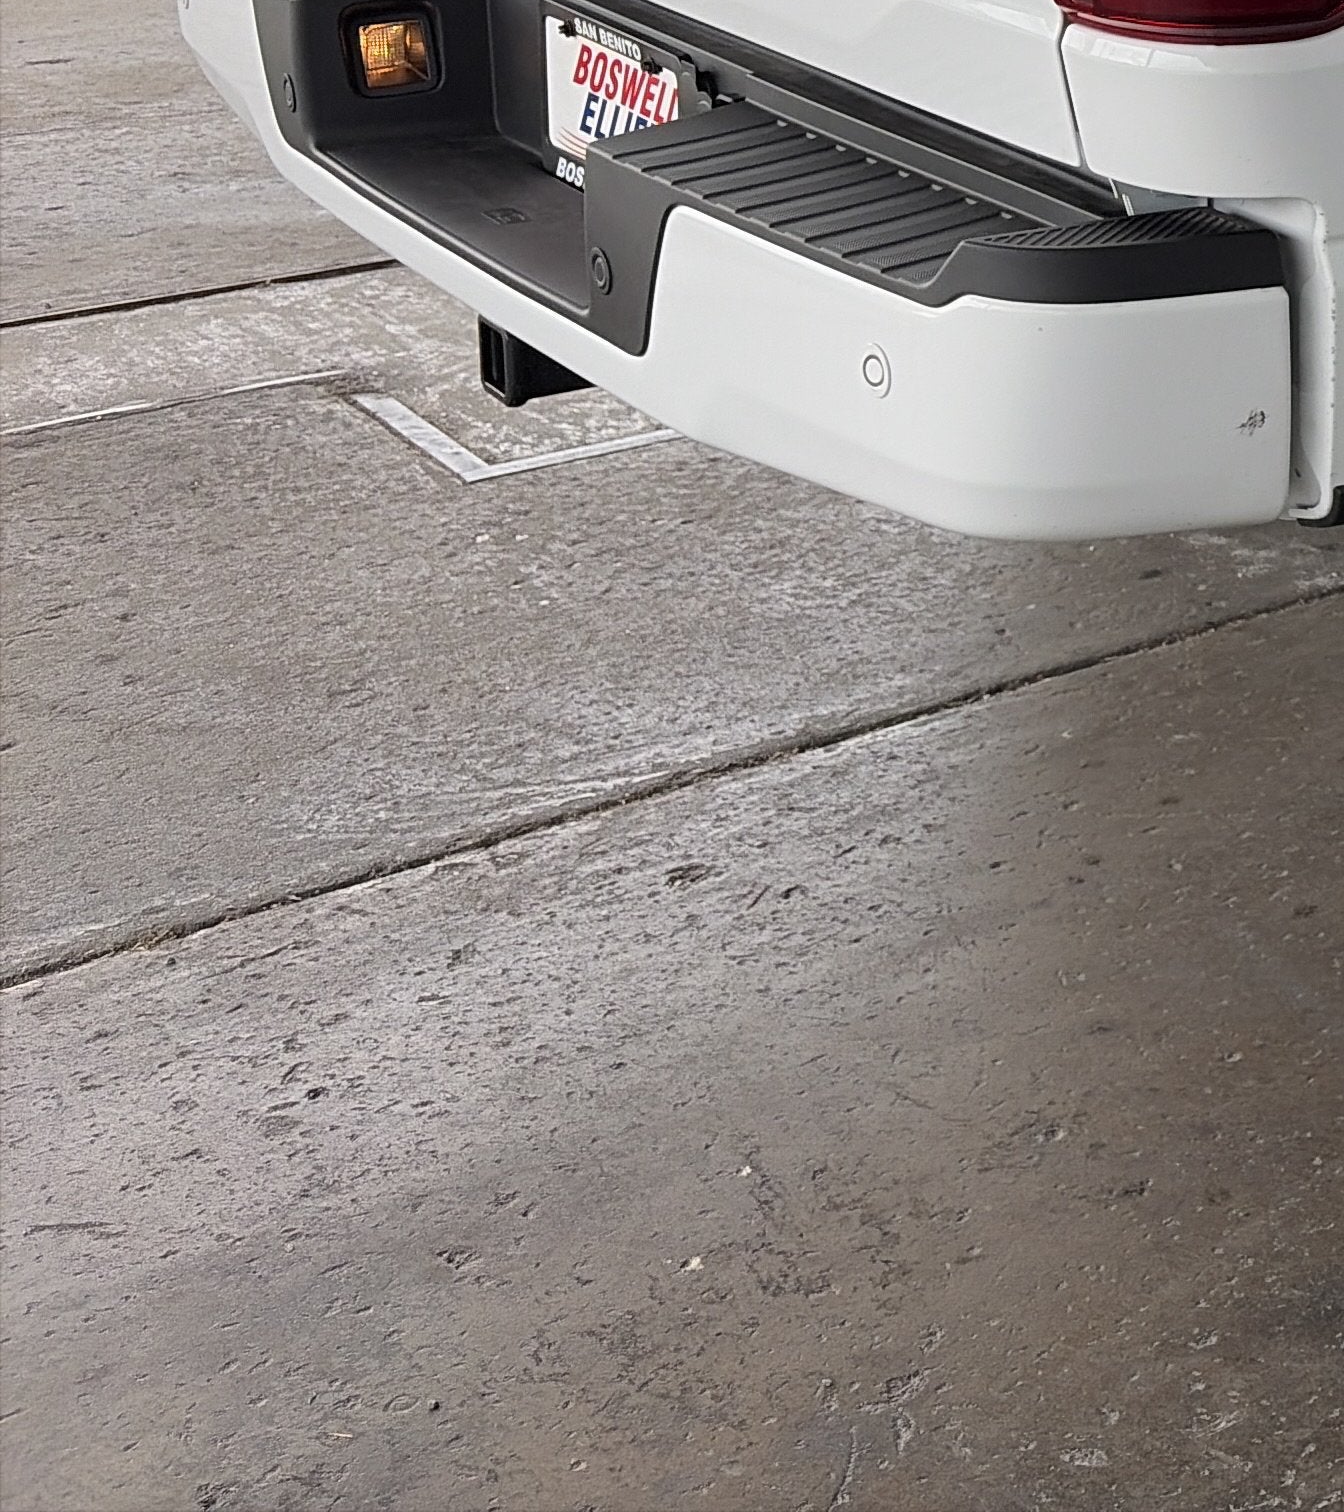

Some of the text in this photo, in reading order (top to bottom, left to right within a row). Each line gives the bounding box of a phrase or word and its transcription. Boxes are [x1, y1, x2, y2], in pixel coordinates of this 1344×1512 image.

[574, 17, 642, 62] SAN BENITO
[555, 156, 585, 187] BOS
